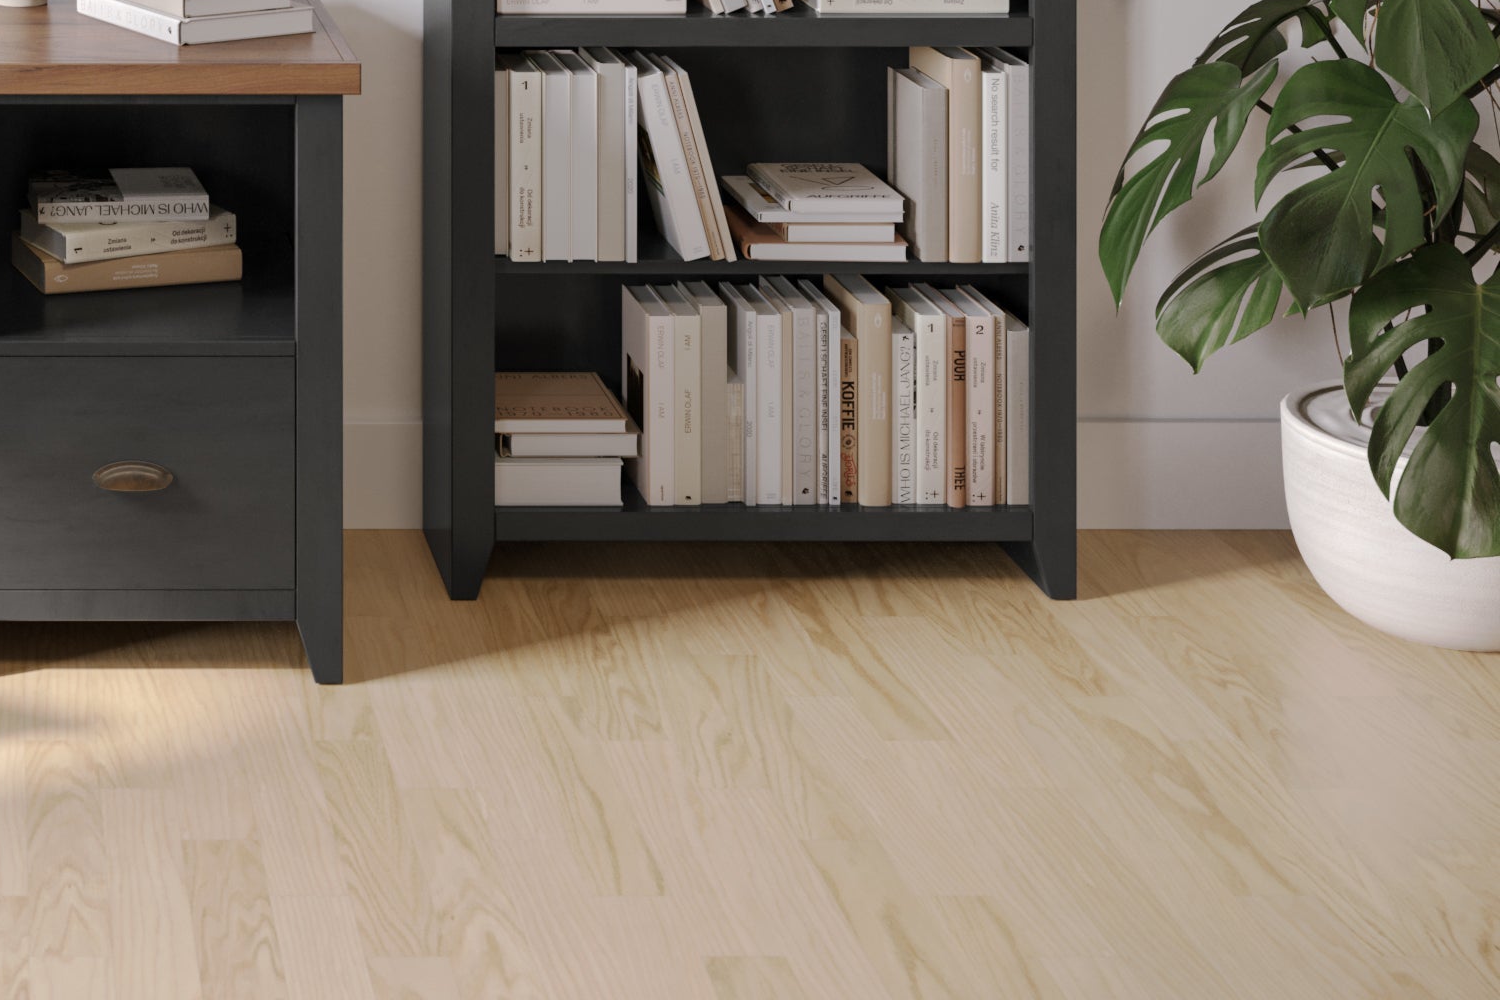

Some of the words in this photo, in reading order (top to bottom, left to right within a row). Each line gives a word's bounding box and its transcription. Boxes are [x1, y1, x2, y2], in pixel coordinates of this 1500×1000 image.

[991, 78, 1000, 91] No
[991, 94, 1000, 126] search
[991, 128, 1000, 156] result
[991, 158, 1000, 172] for
[527, 188, 532, 196] Od
[50, 206, 92, 216] JANG?
[94, 204, 155, 216] MICHAEL
[158, 204, 170, 214] IS
[173, 203, 208, 214] WHO
[990, 201, 1000, 228] Anita
[180, 227, 206, 236] dekoracji
[107, 237, 127, 245] Zmiana
[178, 234, 208, 244] konstrukcji
[990, 230, 1000, 258] Klinz
[103, 245, 132, 253] ustawienia
[975, 324, 984, 335] 2
[684, 334, 691, 346] AM
[900, 346, 910, 388] JANG?
[954, 350, 965, 382] PUUR
[684, 389, 692, 409] OLAF
[658, 406, 665, 418] AM
[842, 381, 855, 431] KOFFIE
[684, 410, 692, 434] ERWIN
[900, 393, 910, 450] MICHAEL
[932, 431, 938, 440] Od
[900, 452, 910, 465] IS
[954, 464, 965, 491] THEE
[900, 468, 910, 503] WHO
